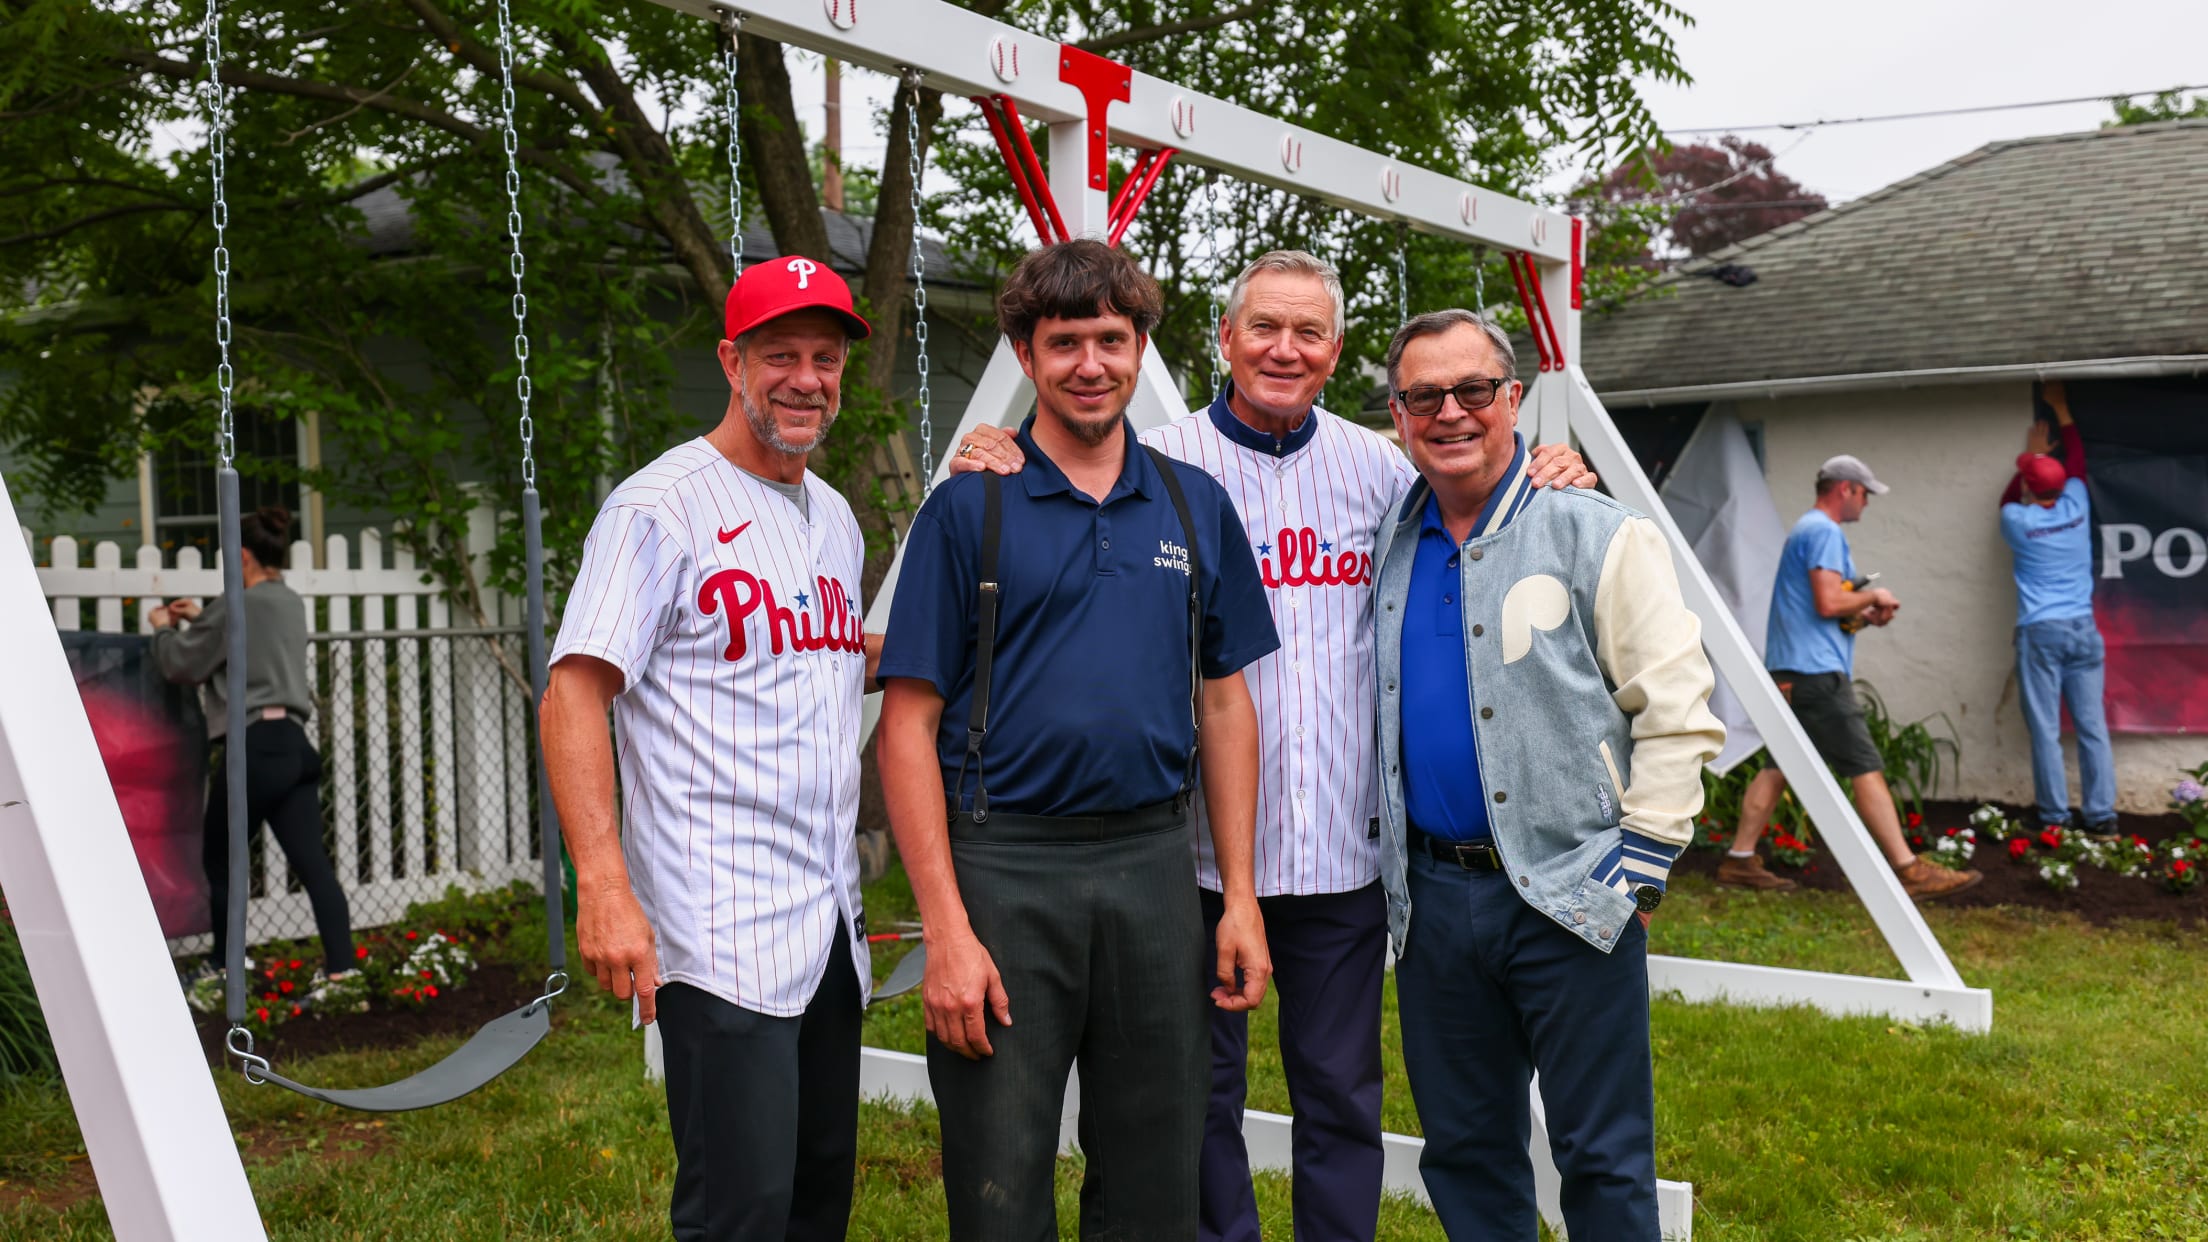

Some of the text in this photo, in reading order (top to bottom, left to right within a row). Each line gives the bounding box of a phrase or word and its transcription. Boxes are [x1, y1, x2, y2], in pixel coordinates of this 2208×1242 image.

[787, 258, 817, 290] P
[1160, 540, 1188, 562] king
[1257, 526, 1373, 589] illies
[2100, 523, 2208, 579] PO
